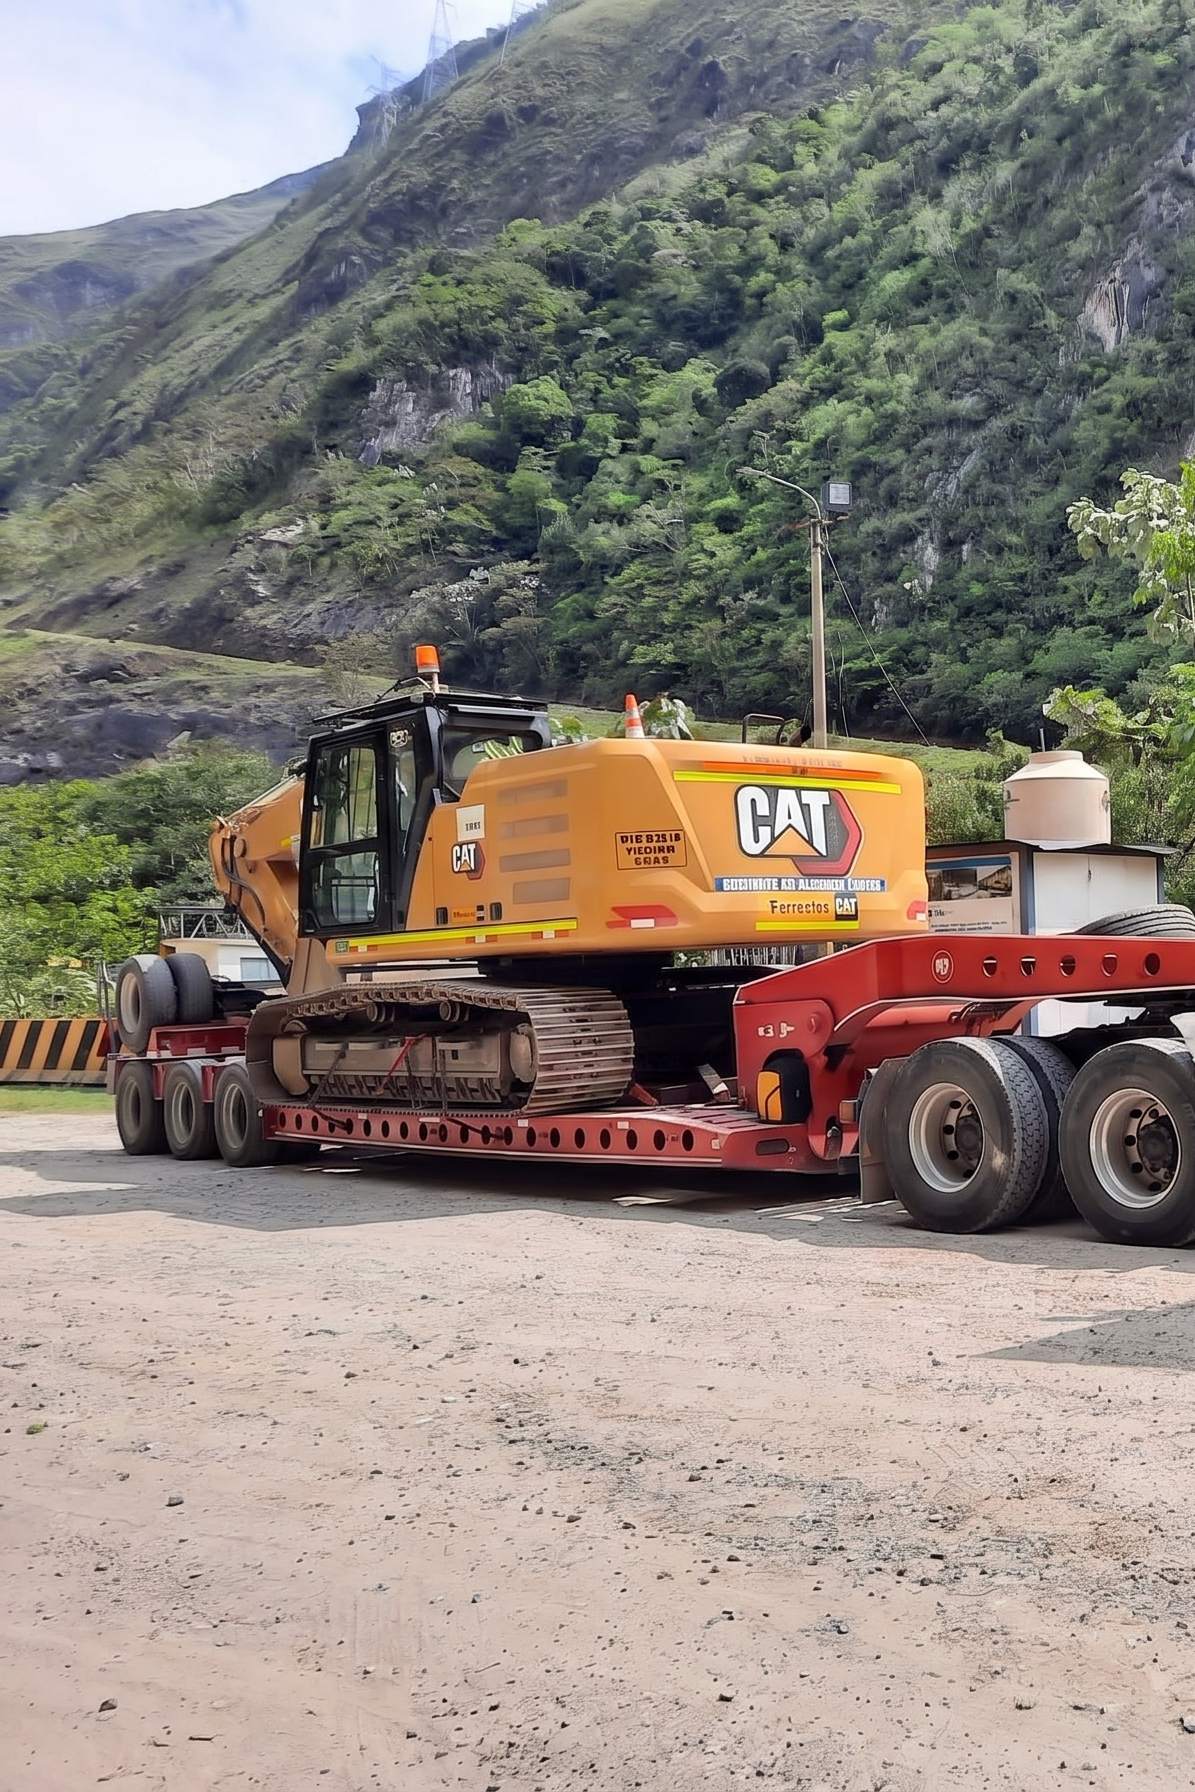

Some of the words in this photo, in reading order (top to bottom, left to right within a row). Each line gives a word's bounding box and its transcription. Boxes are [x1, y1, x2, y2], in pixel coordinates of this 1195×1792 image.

[738, 785, 831, 858] CAT
[452, 843, 476, 872] CAT
[835, 898, 857, 915] CAT
